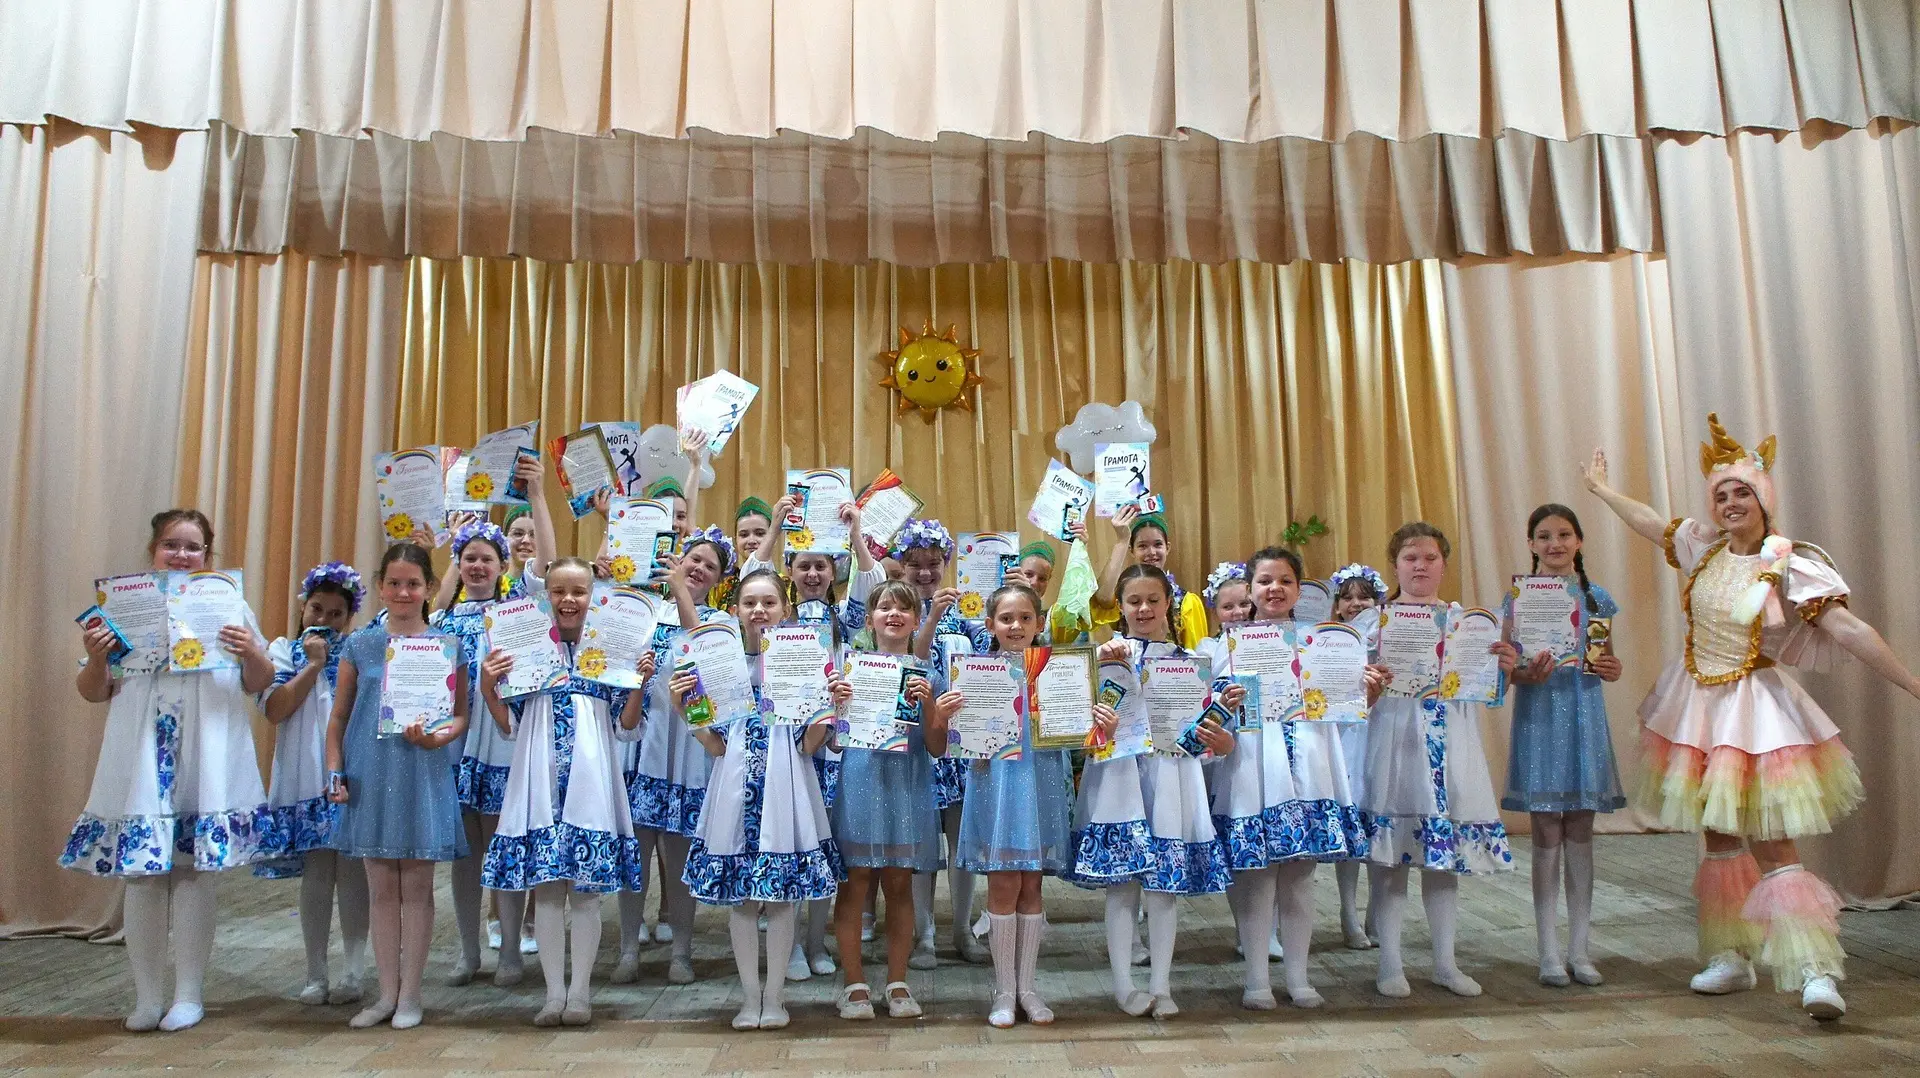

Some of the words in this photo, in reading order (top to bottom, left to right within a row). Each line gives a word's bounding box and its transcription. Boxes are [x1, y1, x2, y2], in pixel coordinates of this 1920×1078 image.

[715, 383, 745, 401] ГРАМОТА
[606, 433, 629, 445] МОТА
[1103, 453, 1139, 466] ГРАМОТА
[1052, 474, 1084, 497] ГРАМОТА
[112, 581, 155, 593] ГРАМОТА
[497, 602, 535, 617] ГРАМОТА
[1394, 611, 1432, 620] ГРАМОТА
[1241, 631, 1280, 641] ГРАМОТА
[401, 644, 441, 652] ГРАМОТА
[858, 660, 898, 670] ГРАМОТА
[965, 663, 1007, 673] ГРАМОТА
[1155, 666, 1195, 674] ГРАМОТА
